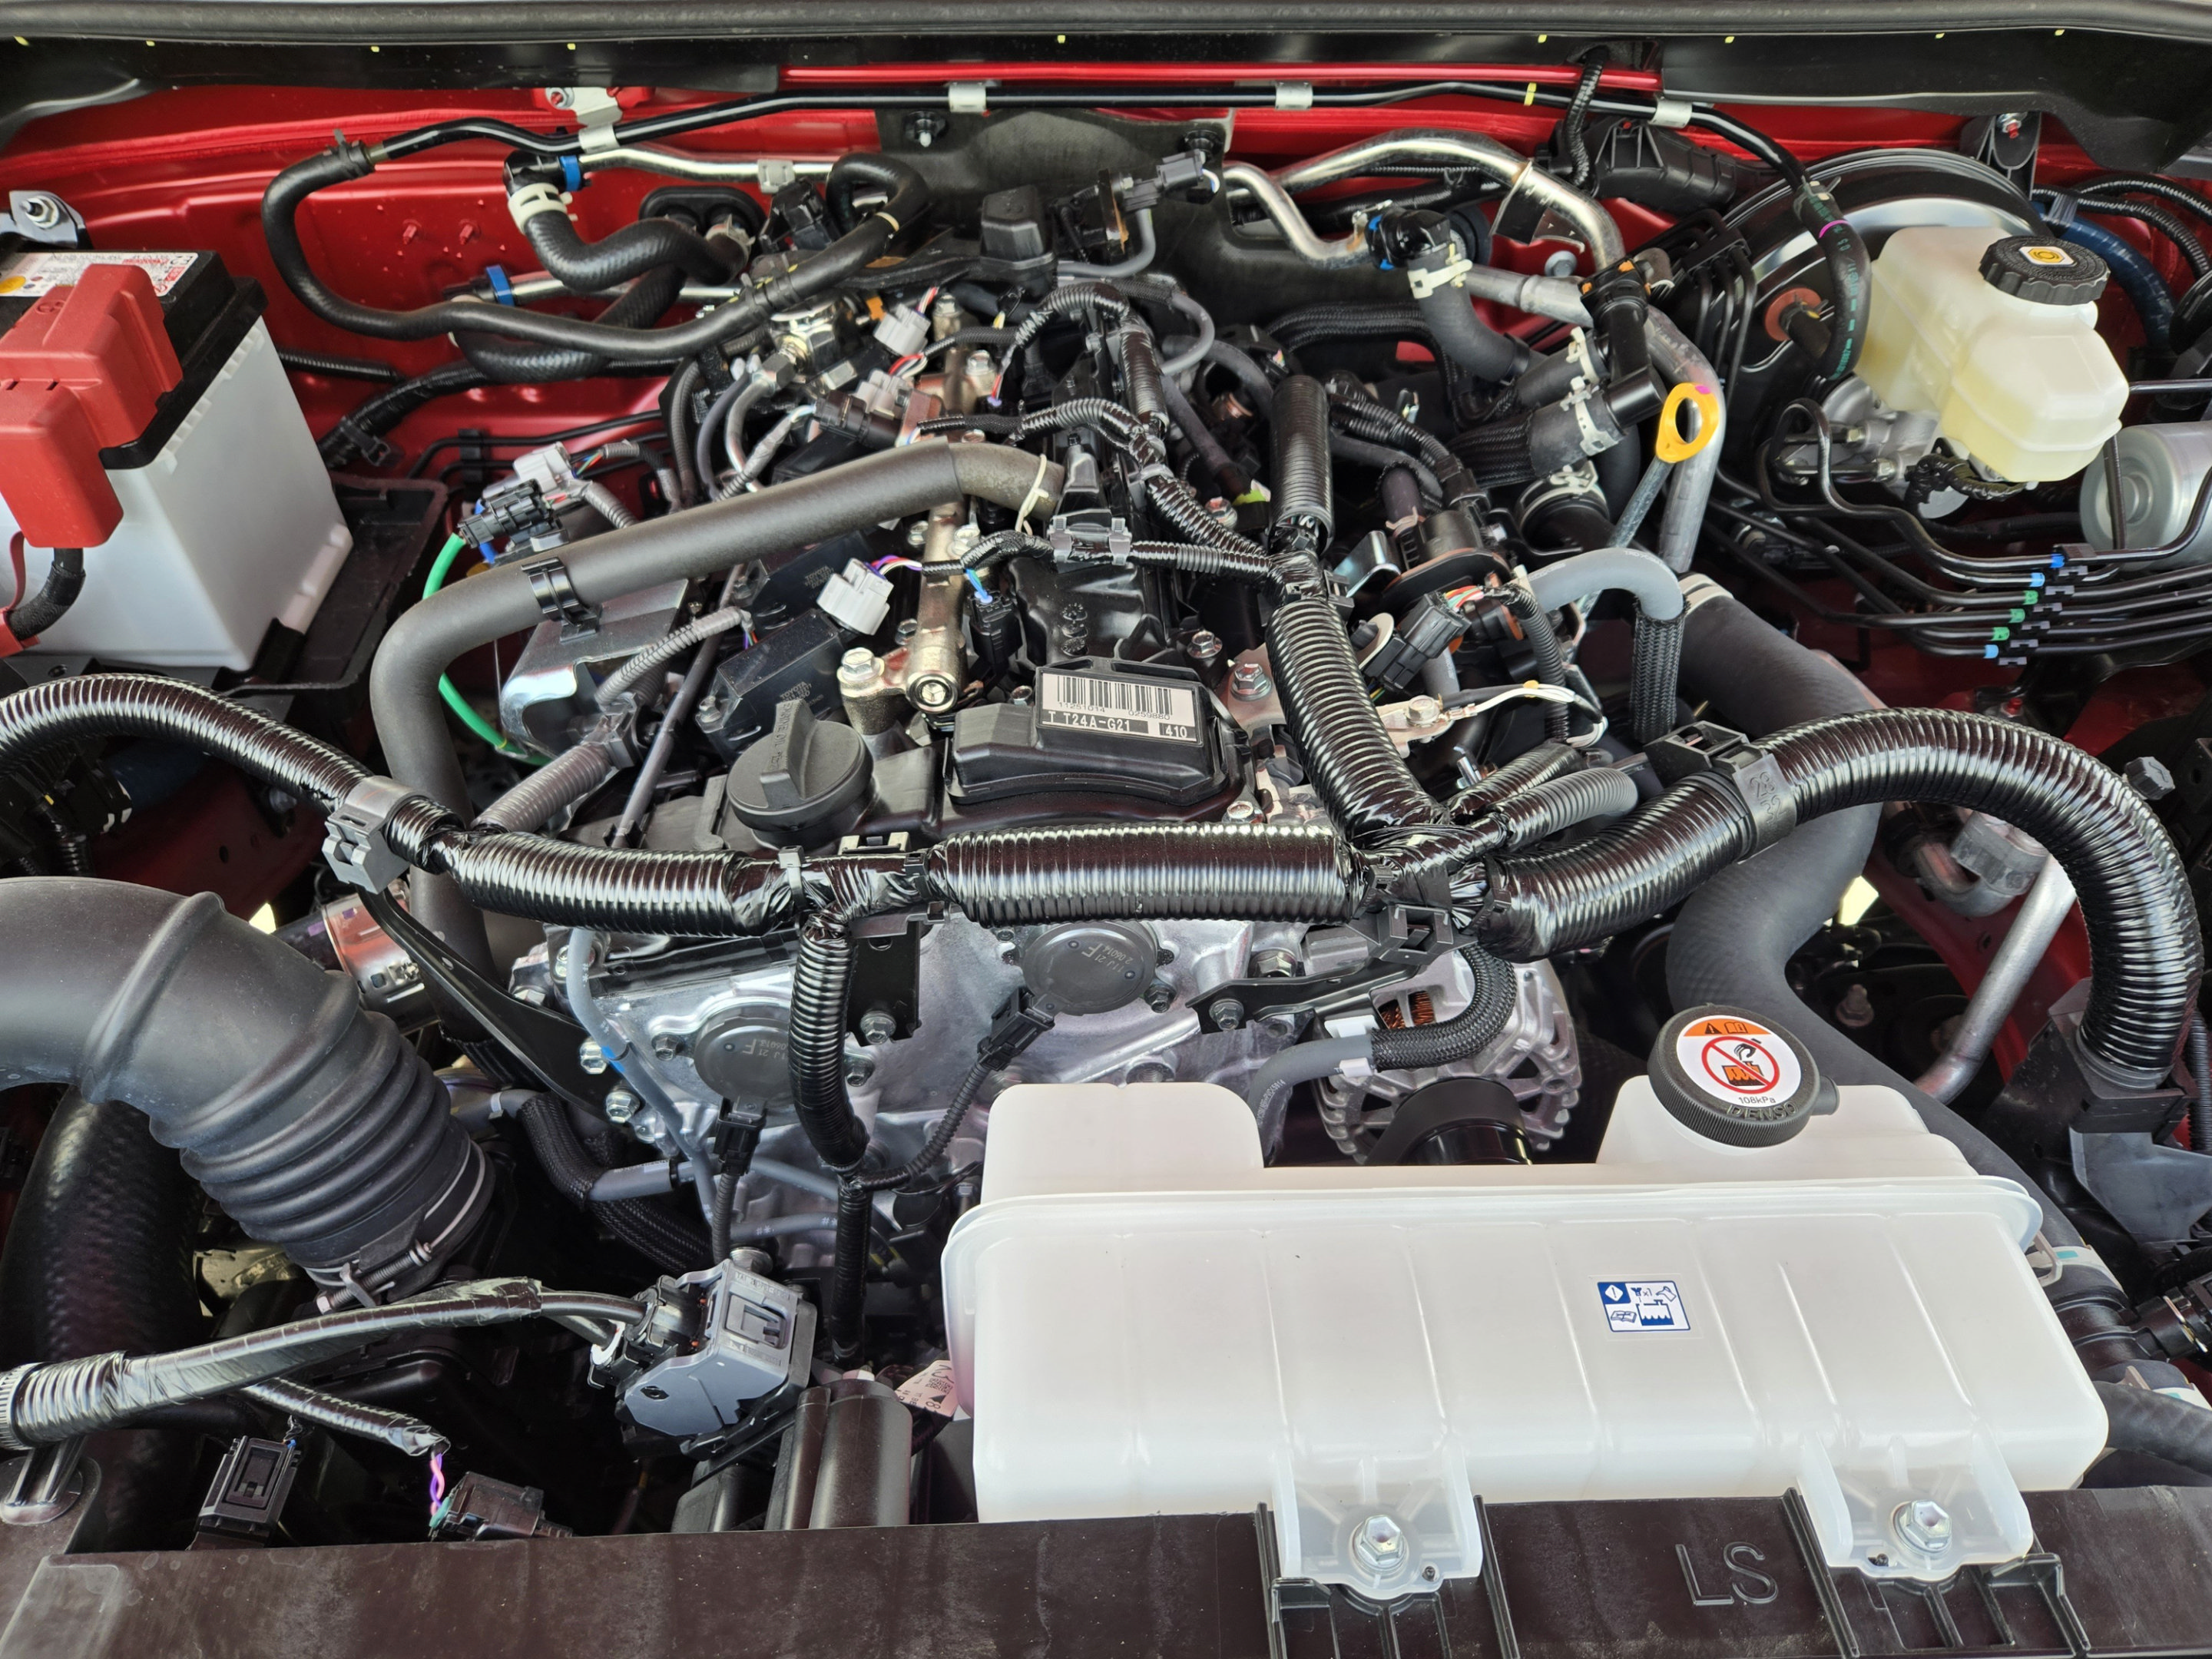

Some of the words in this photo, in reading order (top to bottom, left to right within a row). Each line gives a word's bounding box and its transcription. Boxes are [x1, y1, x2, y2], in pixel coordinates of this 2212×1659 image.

[780, 681, 808, 699] TOYOTA
[1058, 701, 1106, 713] 11251014
[1128, 710, 1171, 720] 0259880
[1048, 710, 1055, 724] T
[1063, 713, 1131, 732] T24A-G21
[1164, 724, 1188, 738] 410
[1750, 771, 1776, 797] 28
[1760, 794, 1787, 823] 32
[1081, 943, 1104, 959] F
[742, 1038, 757, 1055] F
[1738, 1096, 1777, 1104] 108kPa
[1726, 1101, 1798, 1121] DENSO
[1675, 1541, 1779, 1606] LS
